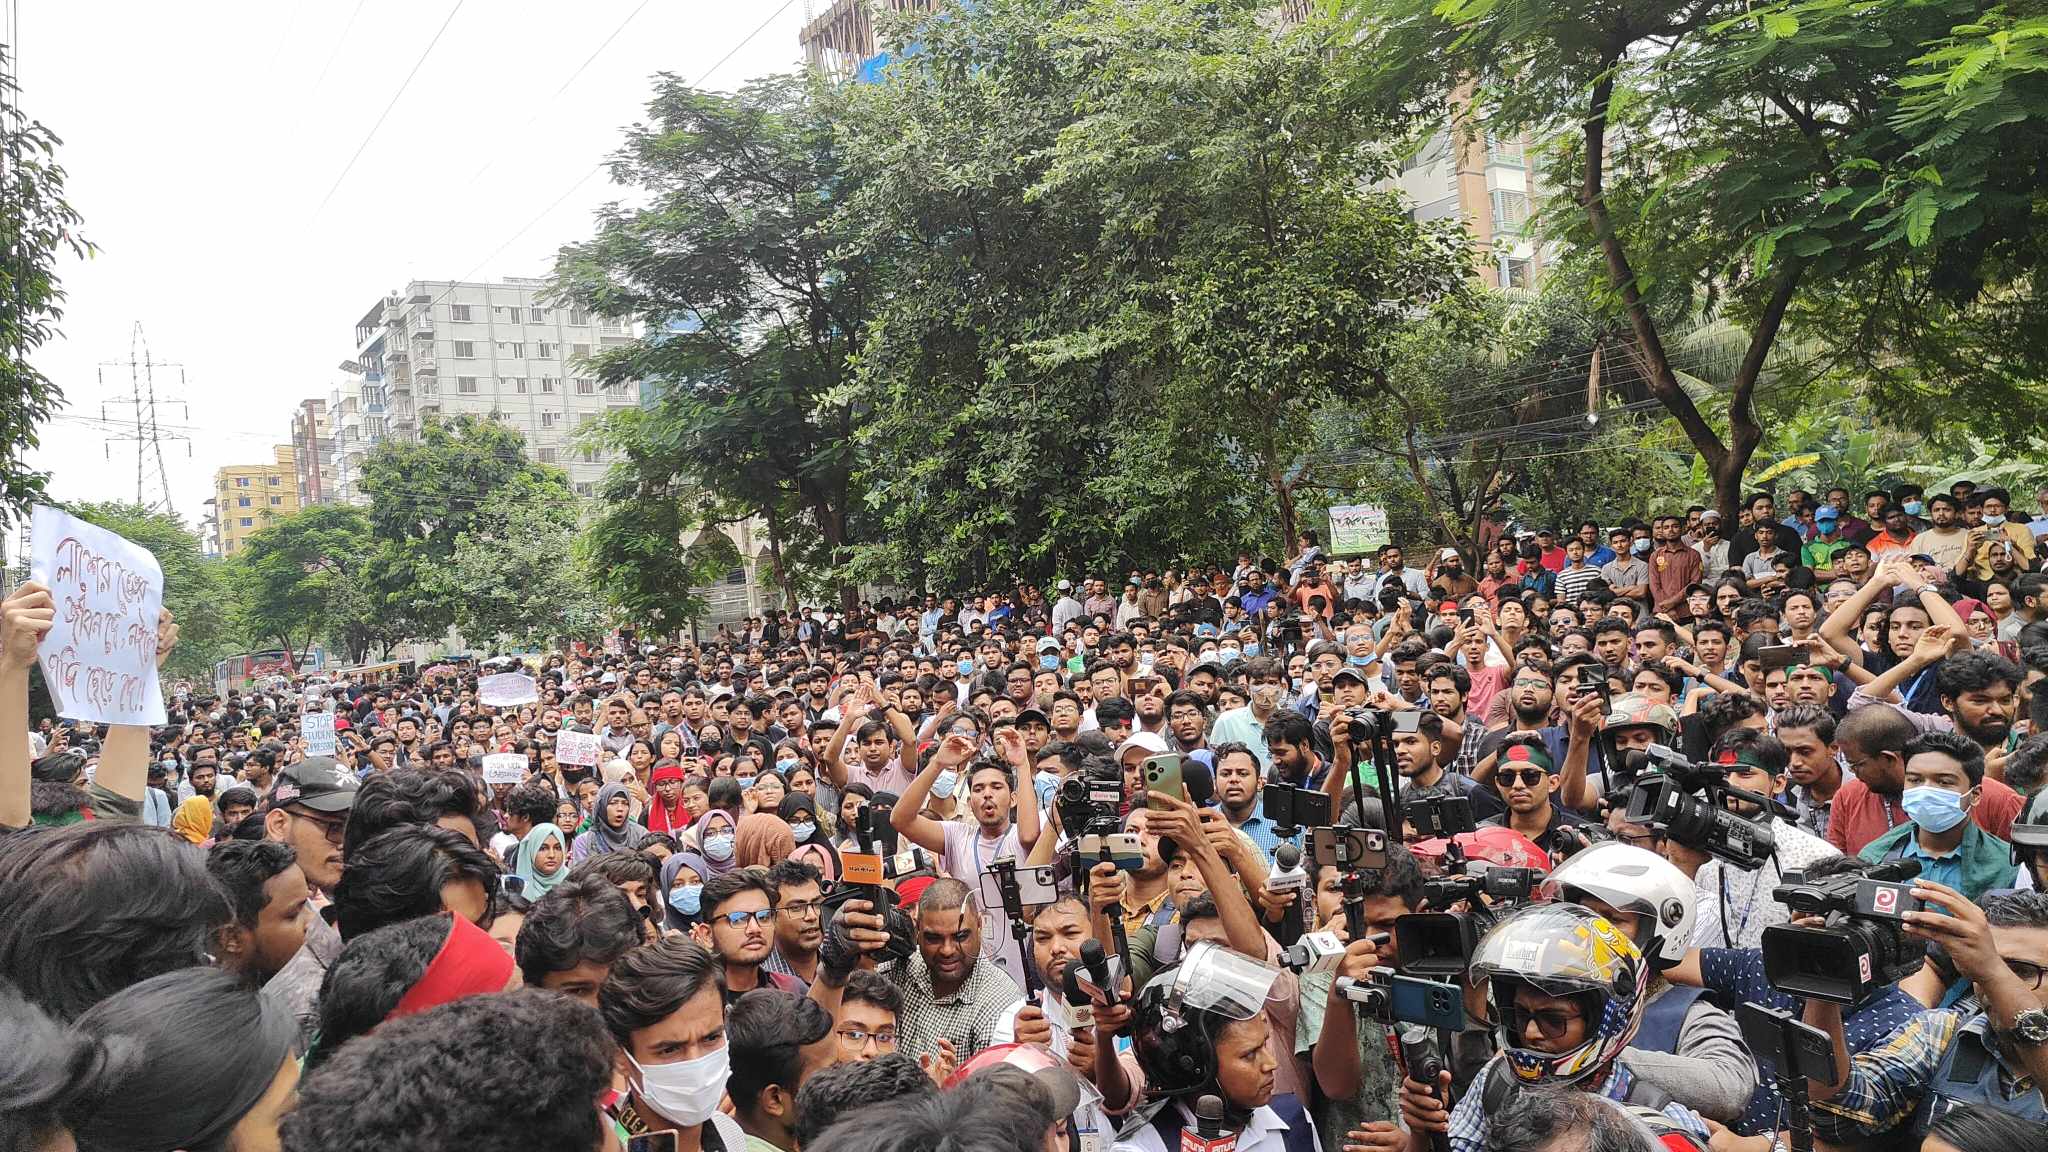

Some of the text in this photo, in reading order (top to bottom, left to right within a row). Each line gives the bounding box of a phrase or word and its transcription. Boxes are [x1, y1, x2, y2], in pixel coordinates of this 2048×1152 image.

[63, 594, 103, 645] জীবন
[48, 646, 81, 704] গদি
[303, 731, 334, 740] STUDENT
[305, 715, 332, 729] STOP
